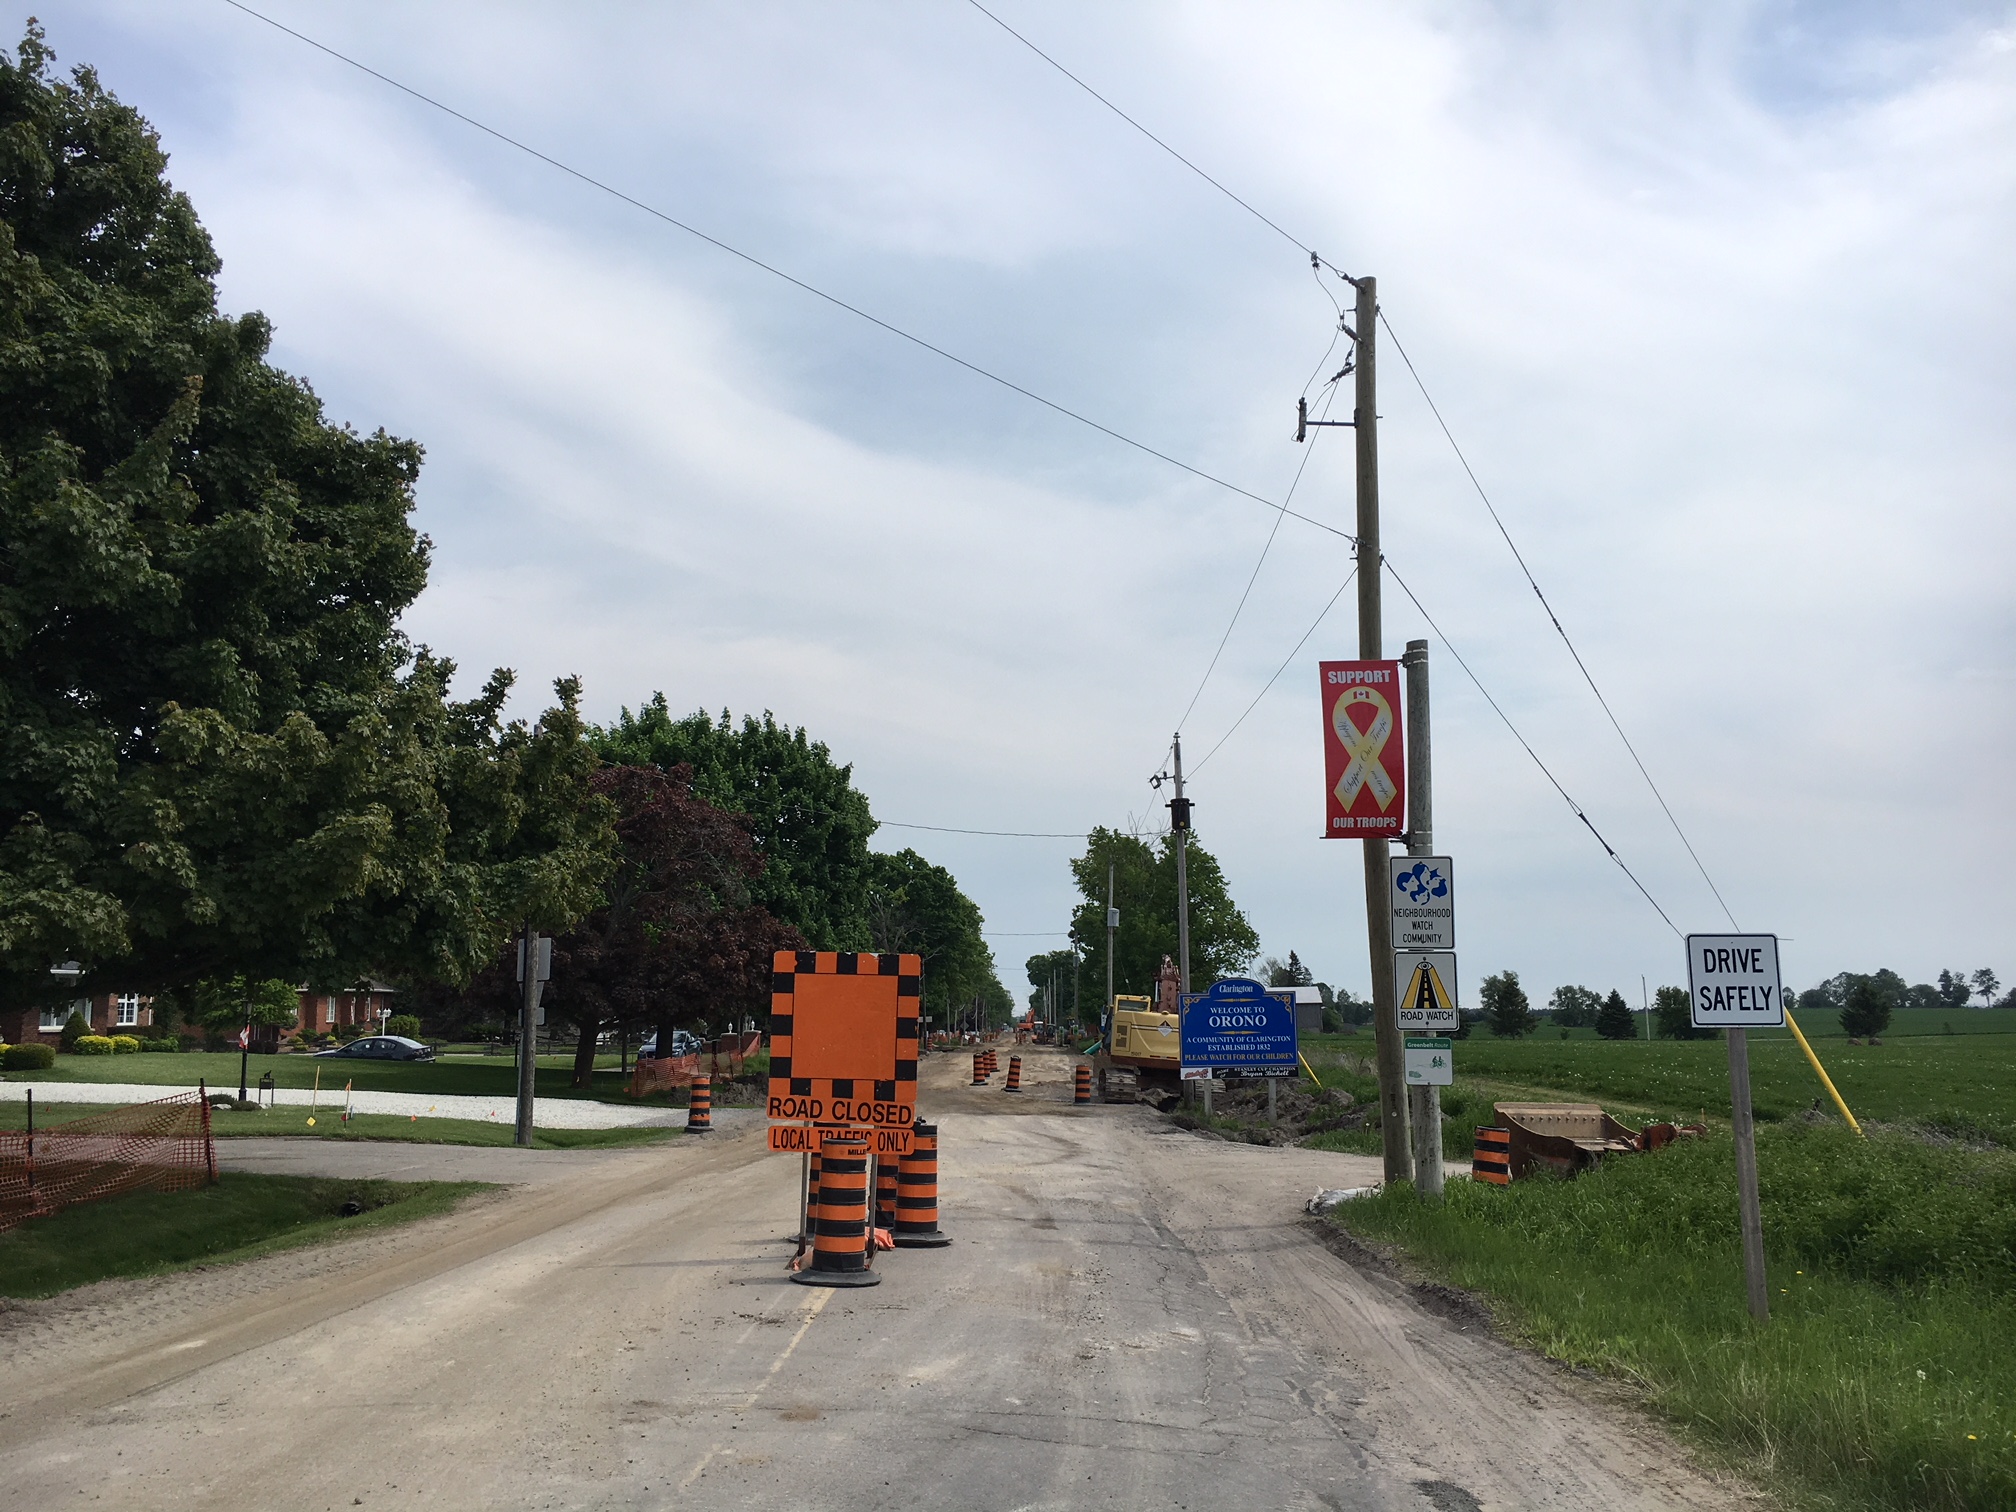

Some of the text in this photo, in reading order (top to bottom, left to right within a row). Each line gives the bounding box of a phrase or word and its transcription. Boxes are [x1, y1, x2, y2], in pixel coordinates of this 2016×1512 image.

[1327, 669, 1391, 685] SUPPORT
[1343, 763, 1364, 794] Support
[1360, 746, 1373, 762] Our
[1332, 816, 1397, 829] OUR TROOPS
[1393, 908, 1451, 918] NEIGHBOURHOOD
[1411, 920, 1434, 930] WATCH
[1402, 933, 1443, 943] COMMUNITY
[1703, 948, 1764, 973] DRIVE
[1219, 984, 1254, 994] Clarington
[1699, 985, 1773, 1011] SAFELY
[1208, 1014, 1267, 1028] ORONO
[1400, 1010, 1454, 1021] ROAD WATCH
[1246, 1035, 1291, 1043] CLARINGTON
[1209, 1053, 1232, 1061] WATCH
[1233, 1053, 1246, 1061] FOR
[1261, 1052, 1294, 1060] CHILDREN
[768, 1097, 912, 1125] ROAD CLOSED
[772, 1128, 814, 1151] LOCAL
[877, 1131, 910, 1153] ONLY
